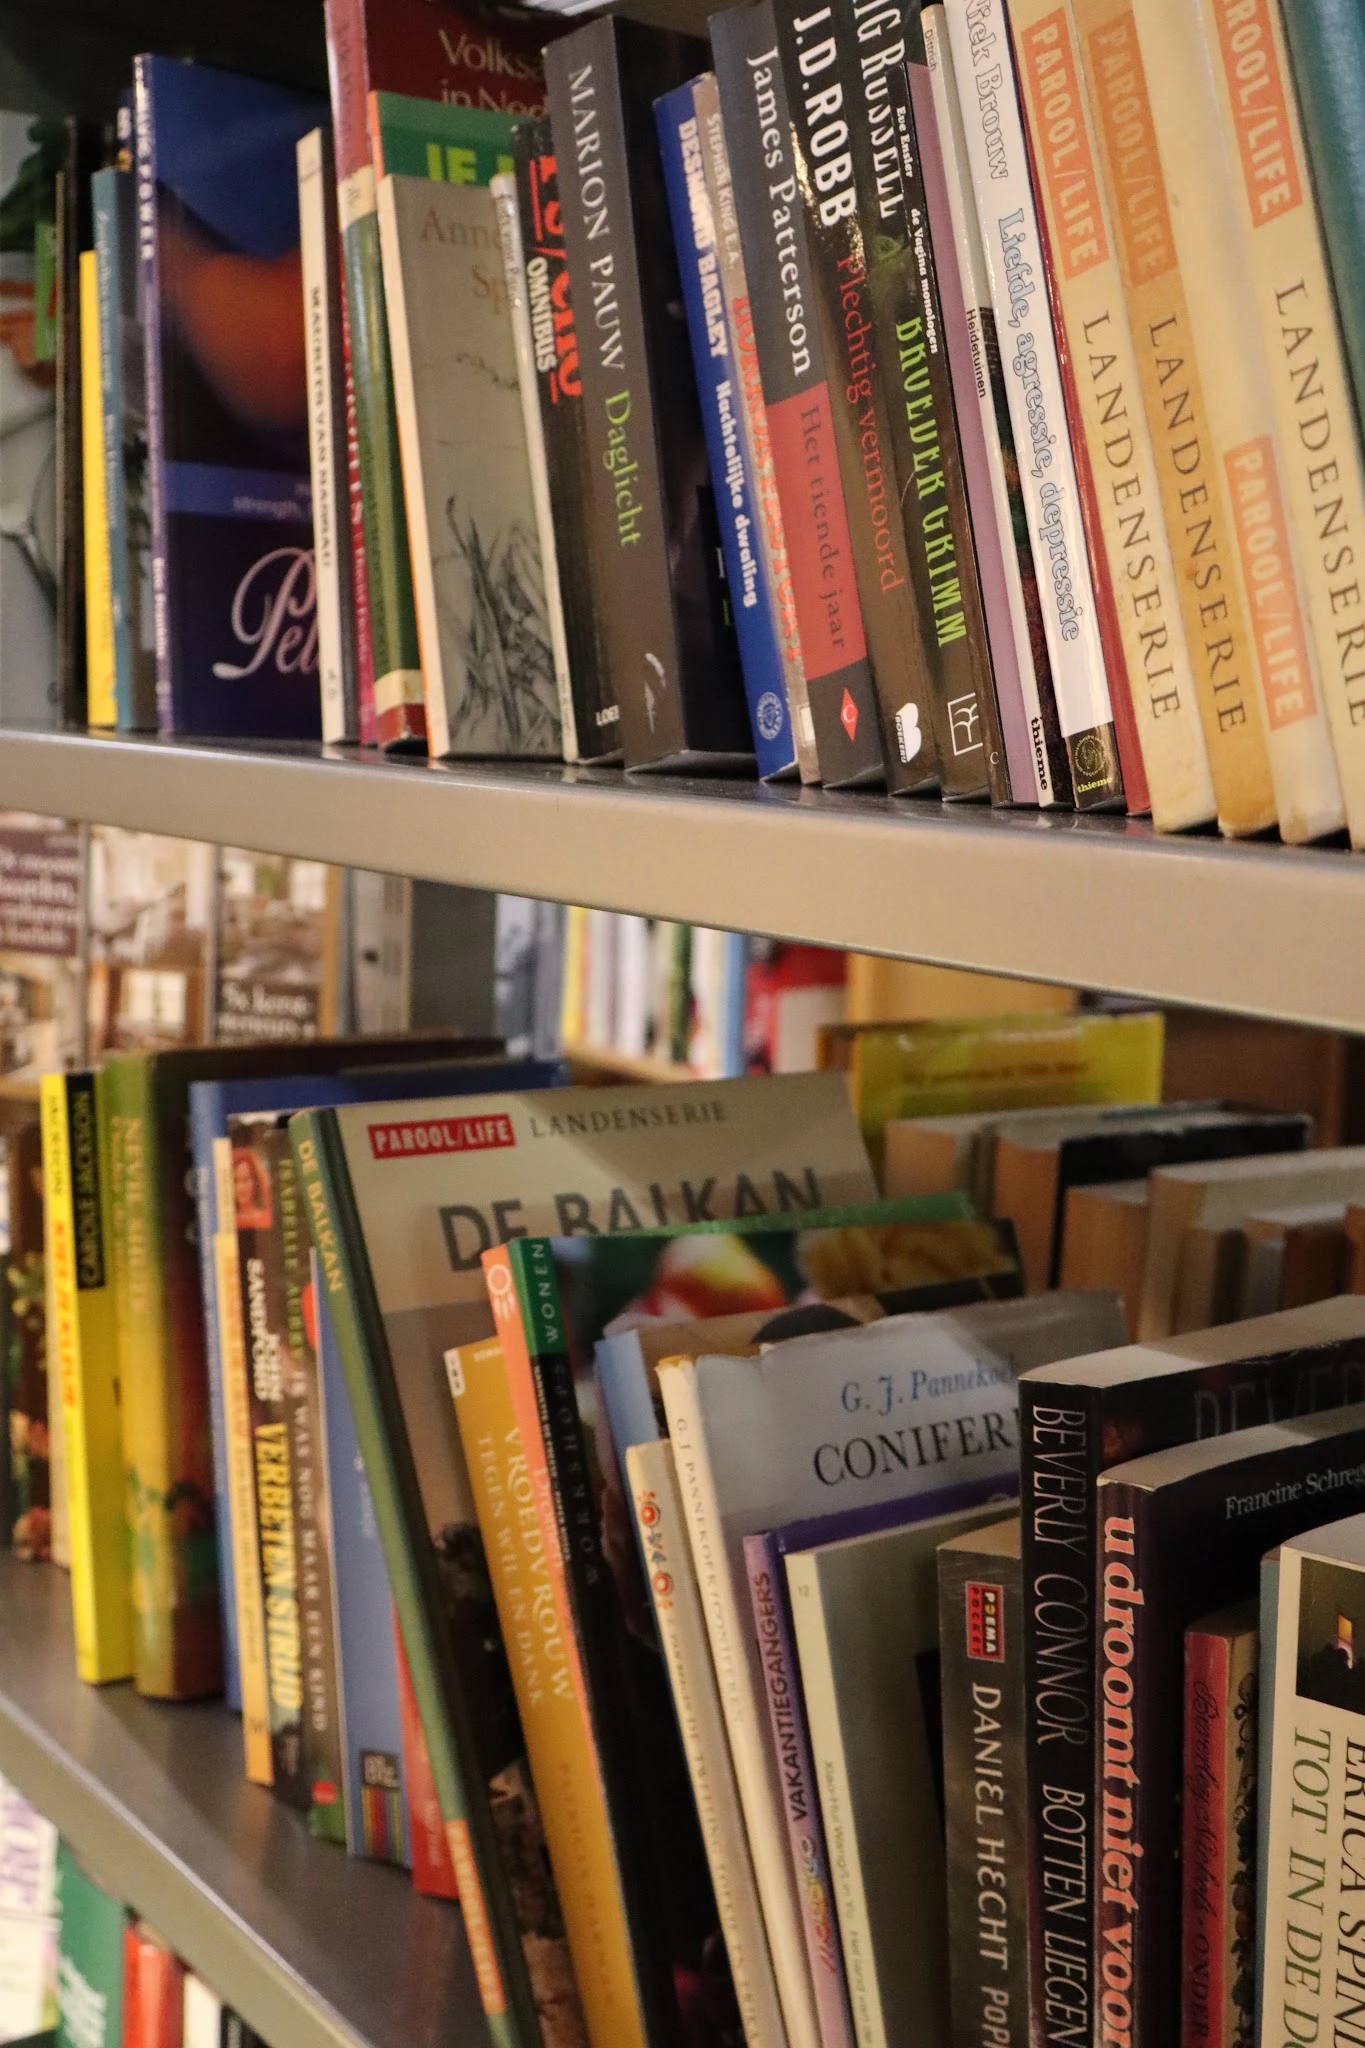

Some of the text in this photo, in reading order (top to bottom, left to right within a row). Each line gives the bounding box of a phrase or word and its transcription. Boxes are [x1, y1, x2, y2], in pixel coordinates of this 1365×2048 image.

[975, 63, 1009, 180] Brouw
[1031, 22, 1100, 269] PAROOL/LIFE
[1221, 0, 1291, 215] ROOL/LIFE
[717, 186, 737, 231] KING
[747, 46, 784, 169] James
[769, 175, 812, 377] Patterson
[897, 106, 938, 354] Eve Ensler de Vagina monologen
[925, 29, 986, 398] Dittrich Heidetuinen
[999, 207, 1036, 329] Liefde,
[527, 256, 557, 373] OMNIBUS
[568, 63, 643, 548] MARION PAUW Daglicht
[804, 82, 857, 226] ROBB
[836, 254, 880, 404] Plechtig
[859, 411, 905, 593] vermoord
[698, 252, 728, 358] BAGLEY
[715, 380, 745, 509] Nachtelijke
[734, 513, 758, 608] dwaling
[1012, 332, 1057, 479] agressie,
[1040, 481, 1081, 642] depressie
[1082, 309, 1181, 720] LANDENSERIE
[1150, 316, 1247, 733] LANDENSERIE
[1275, 279, 1365, 727] LANDENSERIE
[1232, 449, 1304, 717] PAROOL/LIFE
[1031, 716, 1048, 791] thieme
[1077, 776, 1113, 793] thieme
[374, 1102, 728, 1152] PAROOL/LIFE LANDENSERIE
[299, 1140, 344, 1292] DE BALKAN
[438, 1199, 529, 1272] DE
[531, 1243, 559, 1344] WONEN
[813, 1407, 1020, 1487] CONIFER
[841, 1380, 870, 1413] G.
[878, 1372, 902, 1417] J.
[254, 1423, 297, 1589] VERBETEN
[1033, 1405, 1088, 1557] BEVERLY
[1104, 1516, 1135, 1554] u
[1225, 1481, 1302, 1520] Francine
[478, 1436, 506, 1518] TEGEN
[496, 1526, 519, 1574] WIL
[515, 1631, 543, 1707] DANK
[504, 1427, 575, 1700] VROEDVROUW
[984, 1592, 997, 1653] POEMA
[753, 1571, 808, 1823] VAKANTIEGANGERS
[1034, 1572, 1090, 1746] CONNOR
[1103, 1562, 1145, 1787] droomt
[971, 1682, 1004, 1826] DANIEL
[1041, 1783, 1087, 1922] BOTTEN
[1102, 1789, 1143, 1913] niet
[1281, 1727, 1332, 2048] TOT IN DE D
